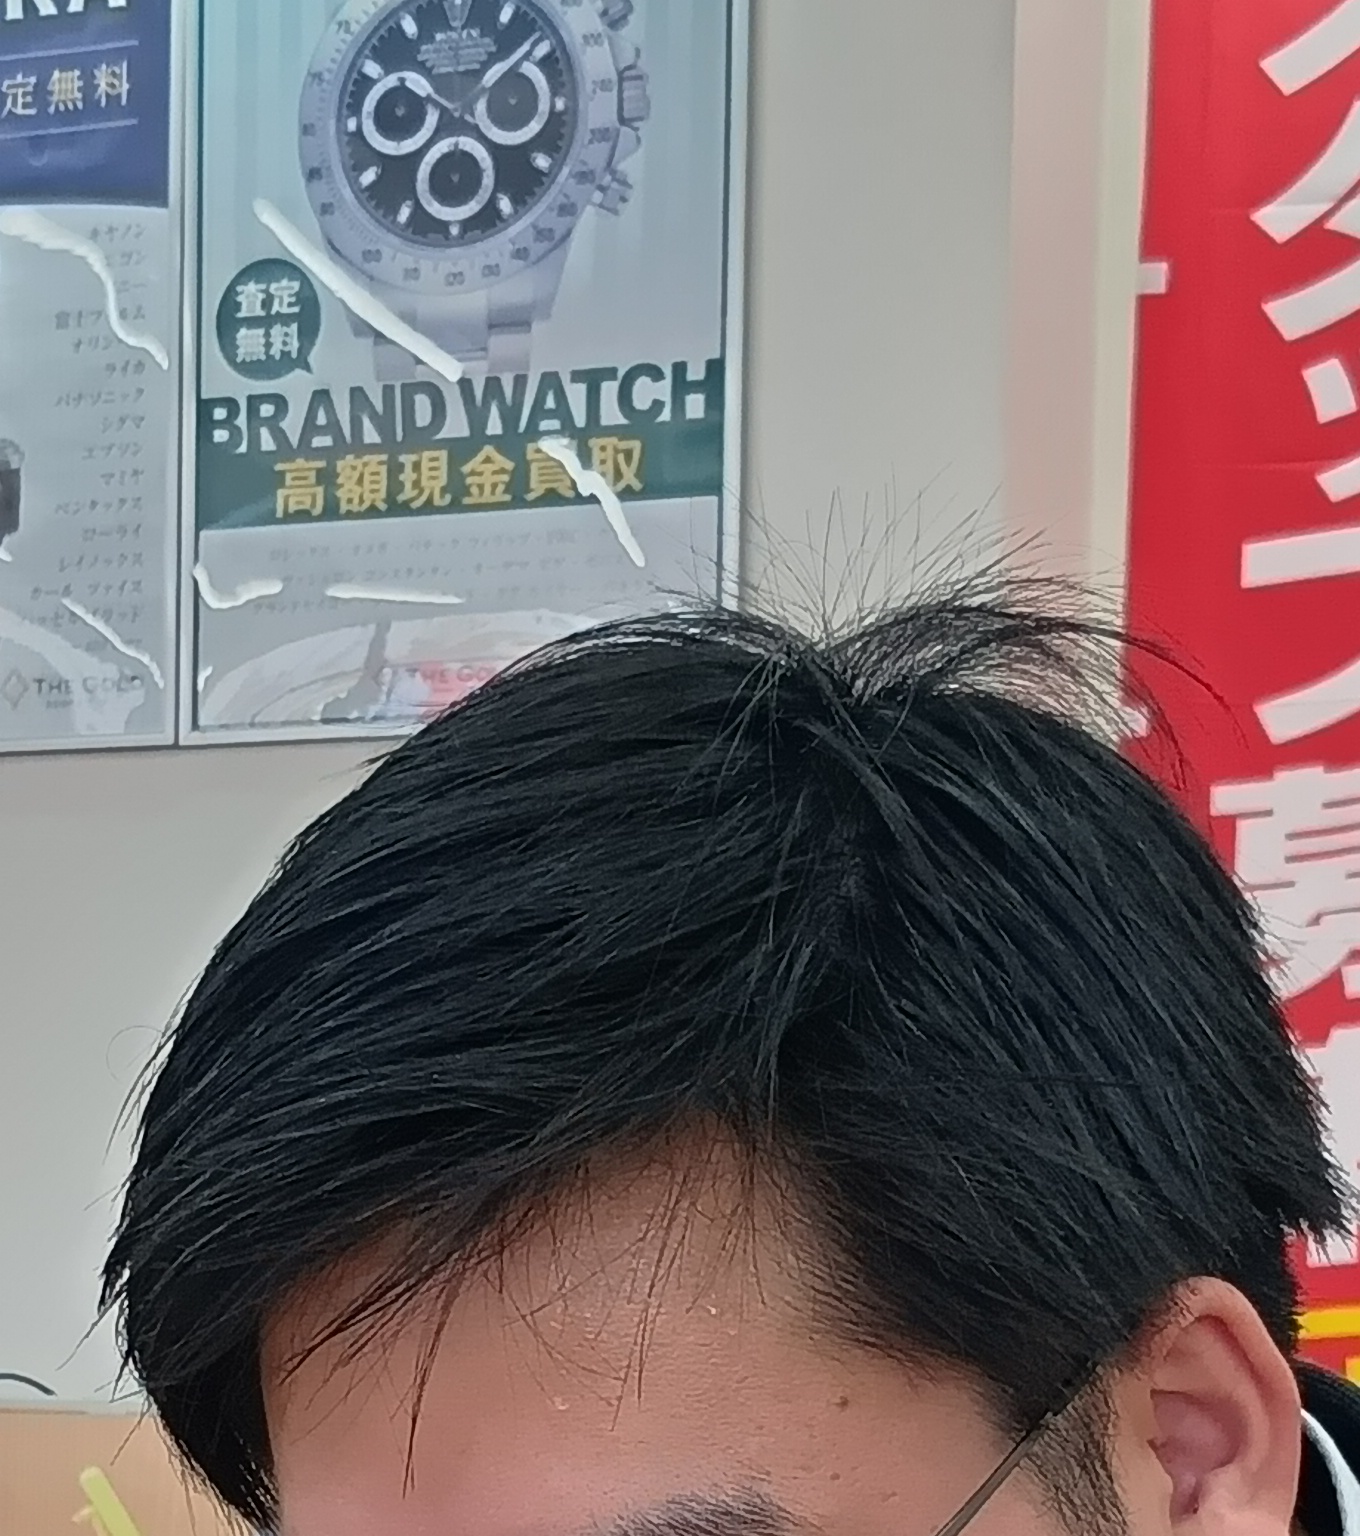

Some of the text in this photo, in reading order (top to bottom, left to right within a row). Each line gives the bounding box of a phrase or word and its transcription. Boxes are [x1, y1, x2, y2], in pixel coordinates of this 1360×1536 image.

[235, 279, 301, 317] 査定
[235, 322, 300, 362] 無料
[200, 357, 723, 455] BRAND WATCH
[274, 436, 645, 519] 高額現金買取
